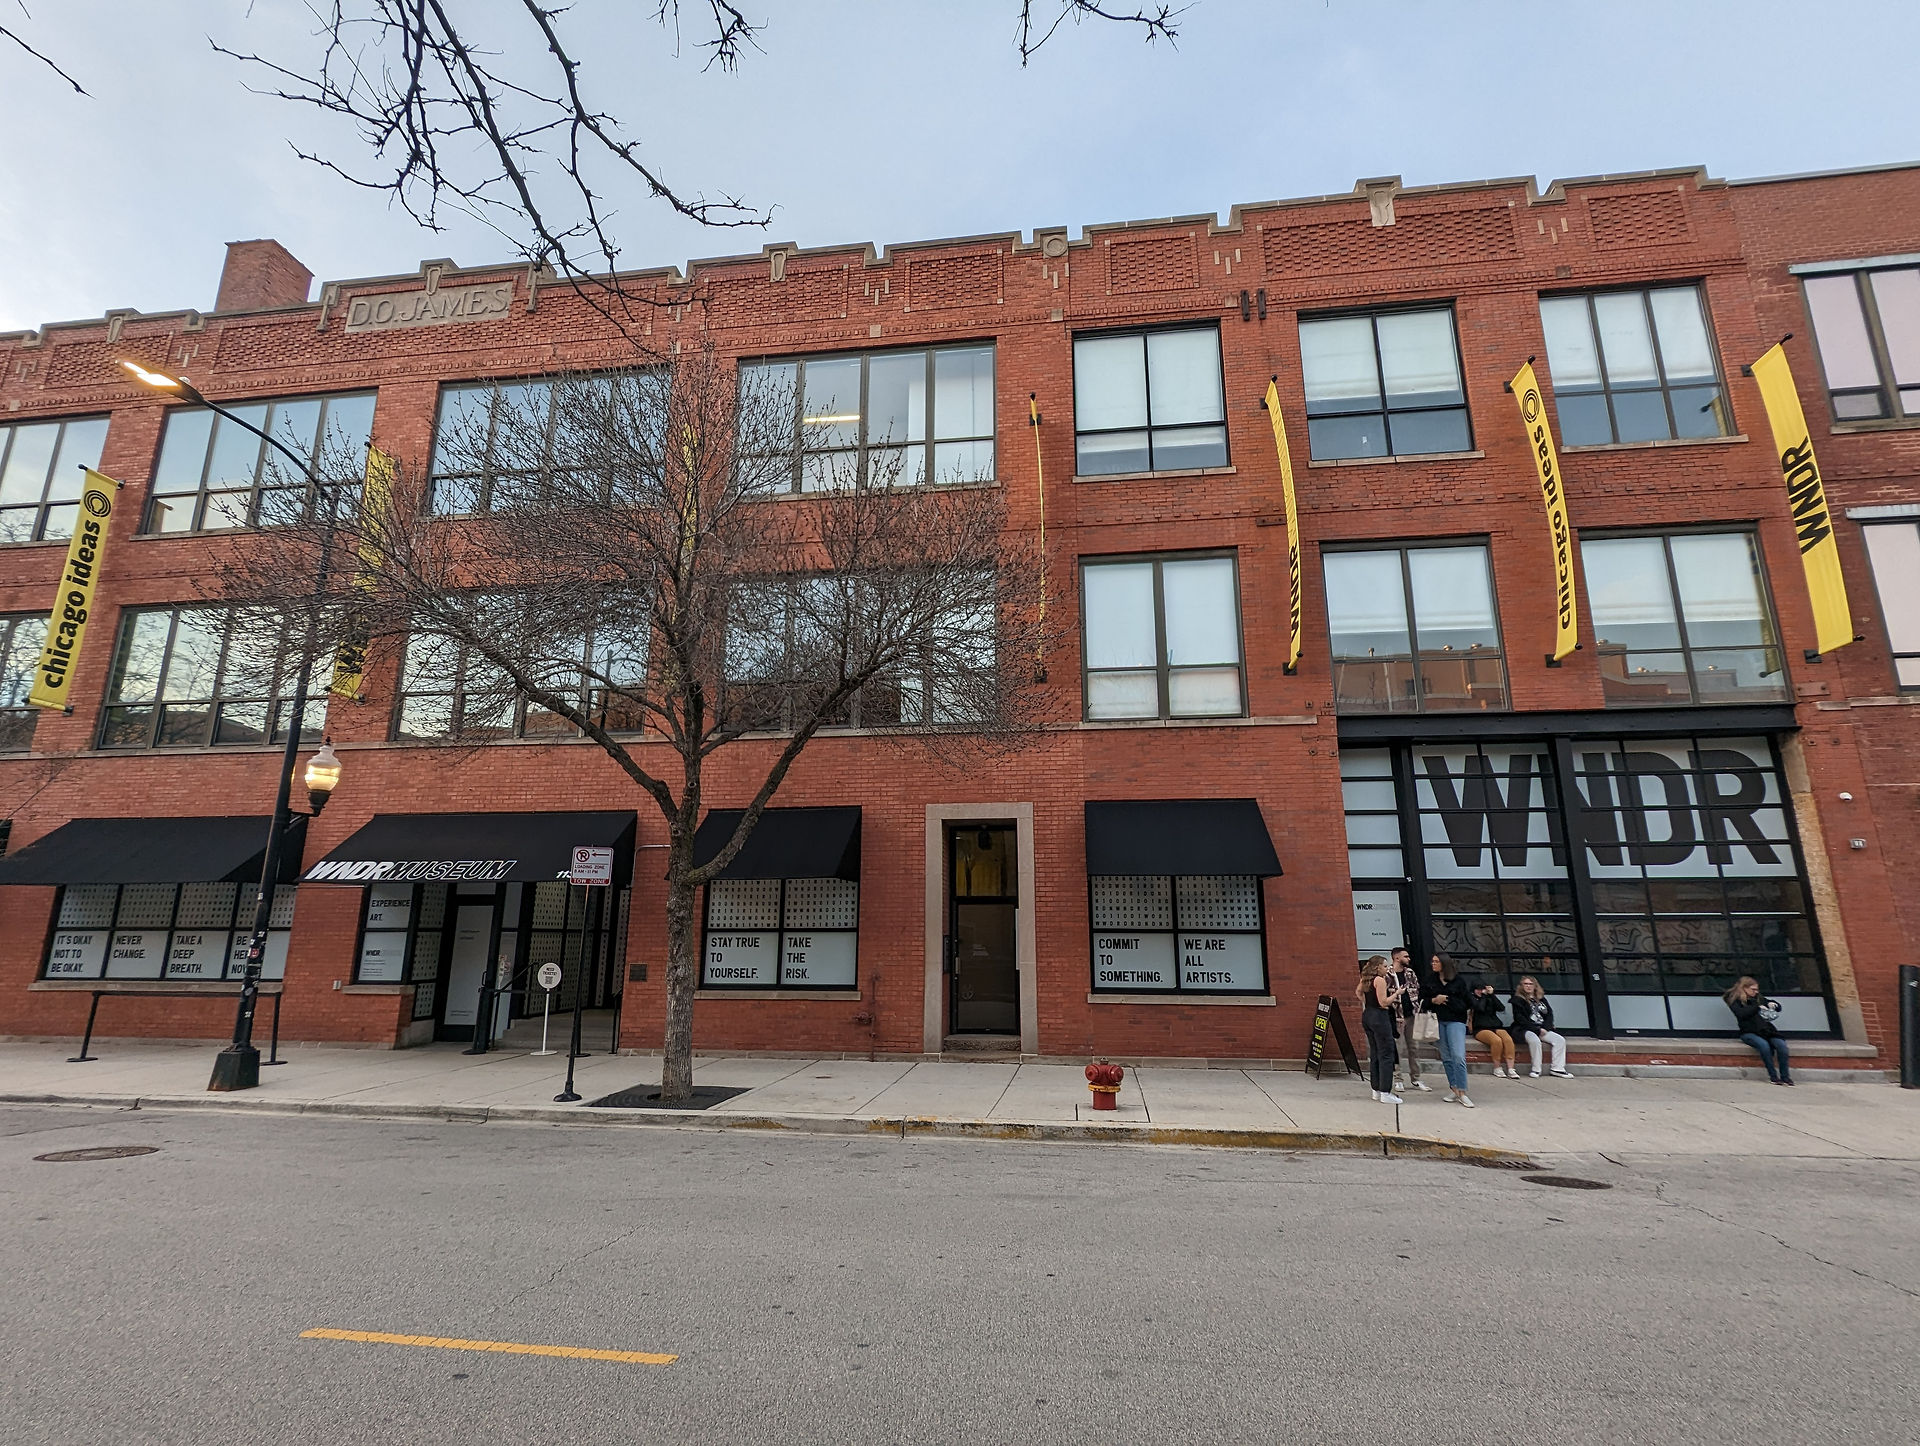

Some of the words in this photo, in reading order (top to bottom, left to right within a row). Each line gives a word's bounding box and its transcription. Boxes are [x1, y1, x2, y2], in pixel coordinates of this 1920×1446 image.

[1532, 424, 1558, 509] ideas
[1781, 435, 1832, 556] WNDR
[1552, 509, 1571, 630] chicago
[42, 589, 88, 688] chicago
[65, 519, 101, 587] ideas
[1421, 748, 1782, 868] WNDR
[1355, 903, 1374, 911] WNDR
[73, 935, 93, 945] OKAY
[115, 935, 142, 945] NEVER
[176, 935, 196, 945] TAKE
[197, 935, 202, 945] A
[236, 936, 248, 946] BE
[711, 936, 734, 948] STAY
[736, 936, 761, 948] TRUE
[788, 936, 812, 948] TAKE
[1098, 938, 1141, 950] COMMIT
[1184, 939, 1202, 950] WE
[1204, 939, 1226, 950] ARE
[53, 949, 70, 959] NOT
[71, 949, 82, 959] TO
[113, 949, 146, 959] CHANGE.
[173, 949, 195, 959] DEEP
[711, 952, 723, 963] TO
[787, 952, 806, 963] THE
[1099, 954, 1114, 966] TO
[1184, 955, 1204, 967] ALL
[50, 963, 62, 973] BE
[709, 967, 759, 979] YOURSELF.
[785, 968, 810, 979] RISK.
[1099, 970, 1164, 983] SOMETHING.
[1185, 971, 1235, 984] ARTISTS.
